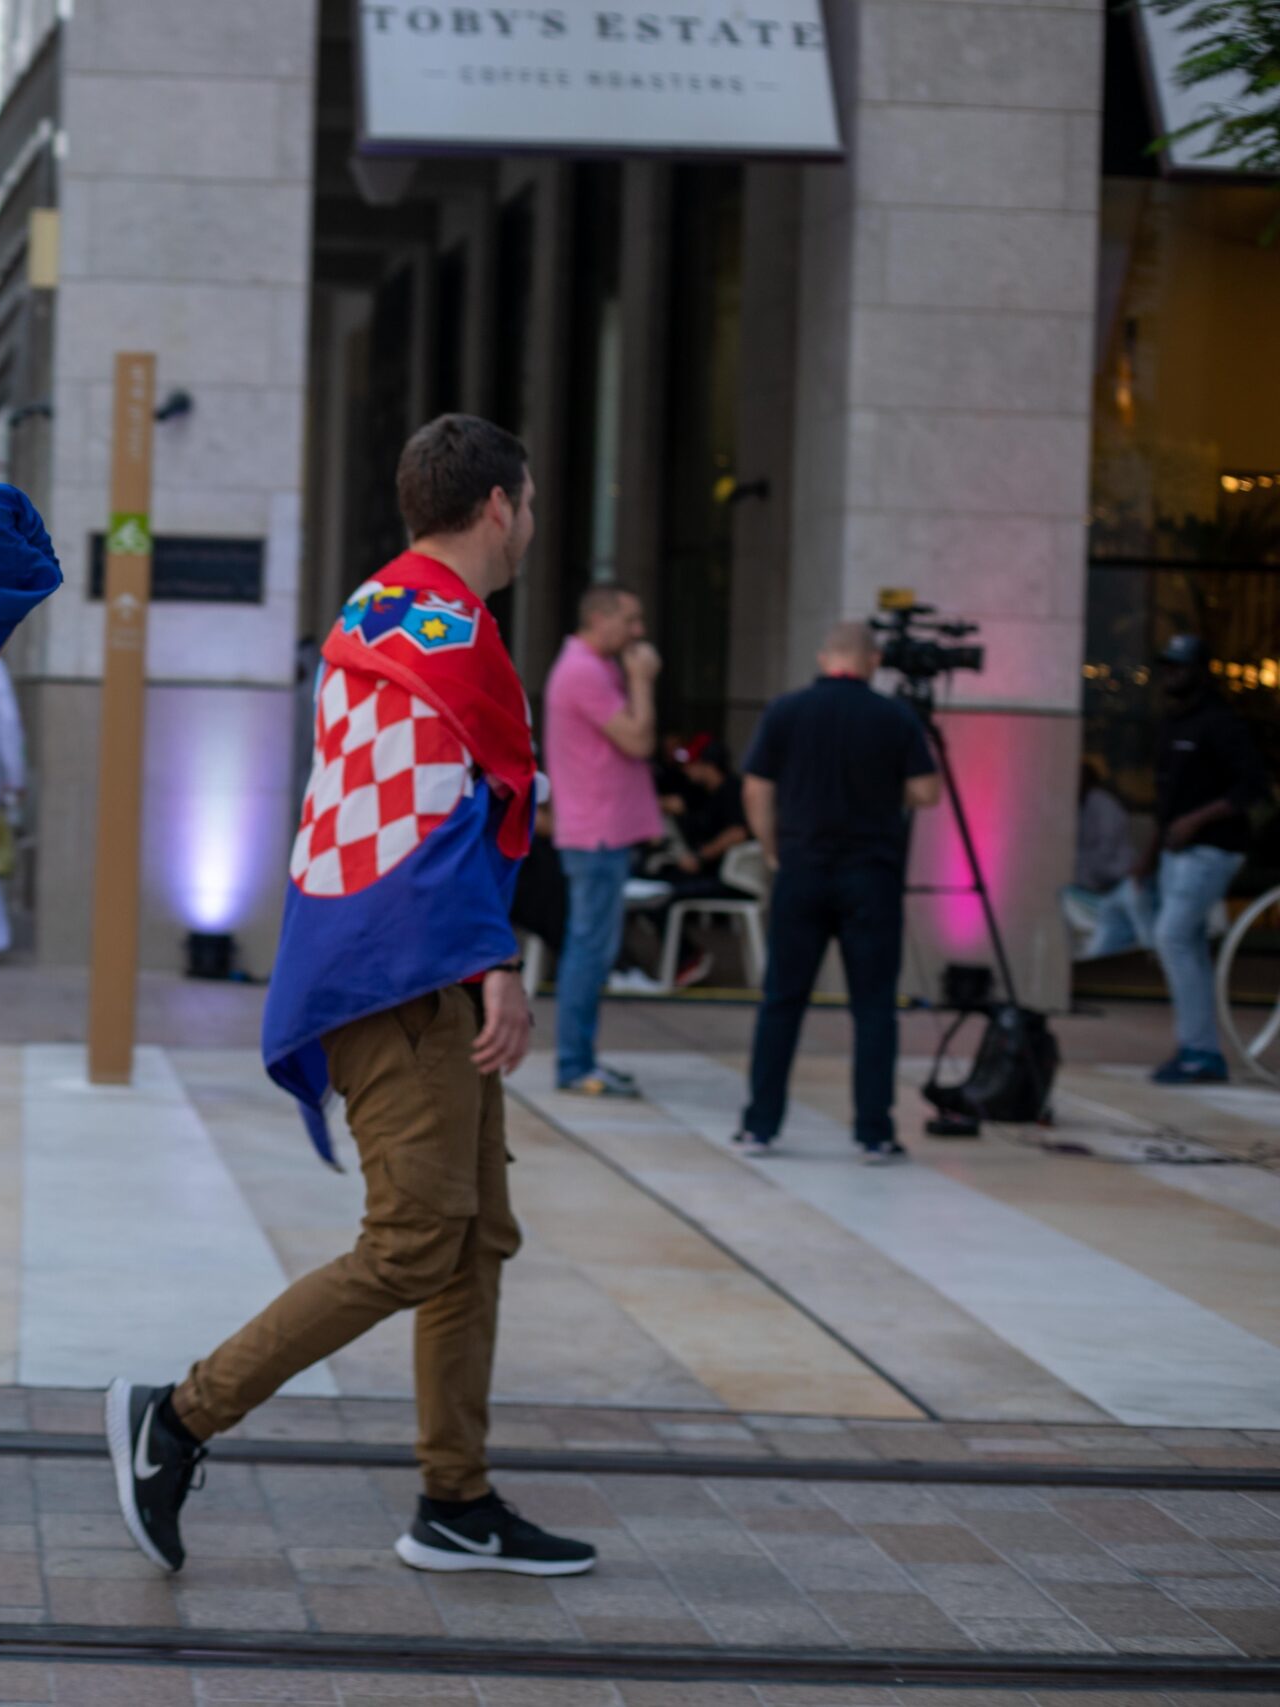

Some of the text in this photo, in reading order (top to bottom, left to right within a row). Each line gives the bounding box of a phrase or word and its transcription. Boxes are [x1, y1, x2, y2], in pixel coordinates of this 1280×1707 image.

[362, 4, 823, 50] TOBY'S ESTATE
[459, 64, 570, 88] COFFEE
